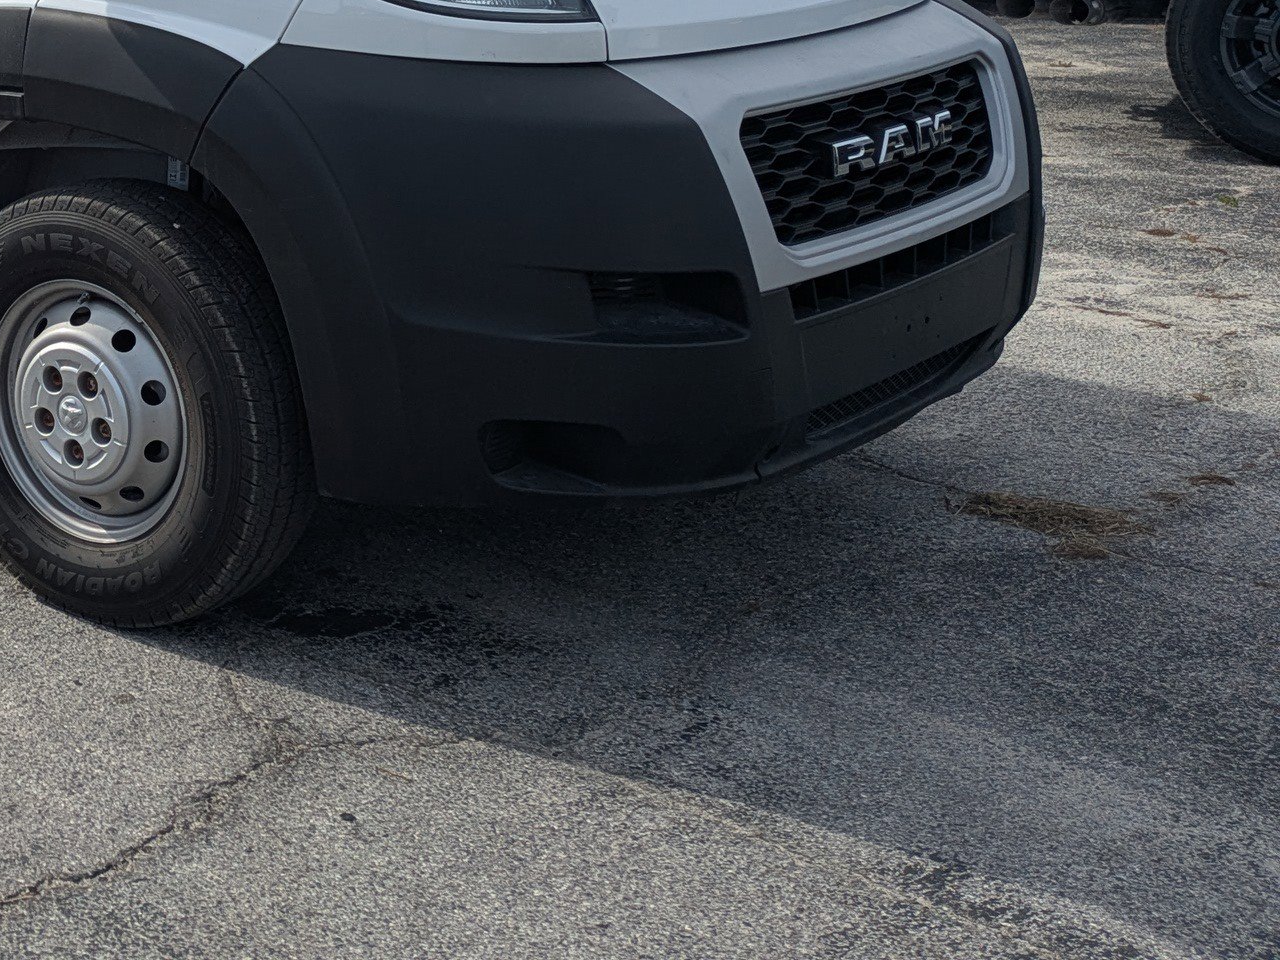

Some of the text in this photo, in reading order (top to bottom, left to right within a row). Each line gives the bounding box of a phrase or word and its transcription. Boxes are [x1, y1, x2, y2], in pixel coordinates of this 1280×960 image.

[833, 110, 953, 177] RAM
[20, 232, 161, 305] NEXEN
[35, 558, 163, 596] ROADIAN
